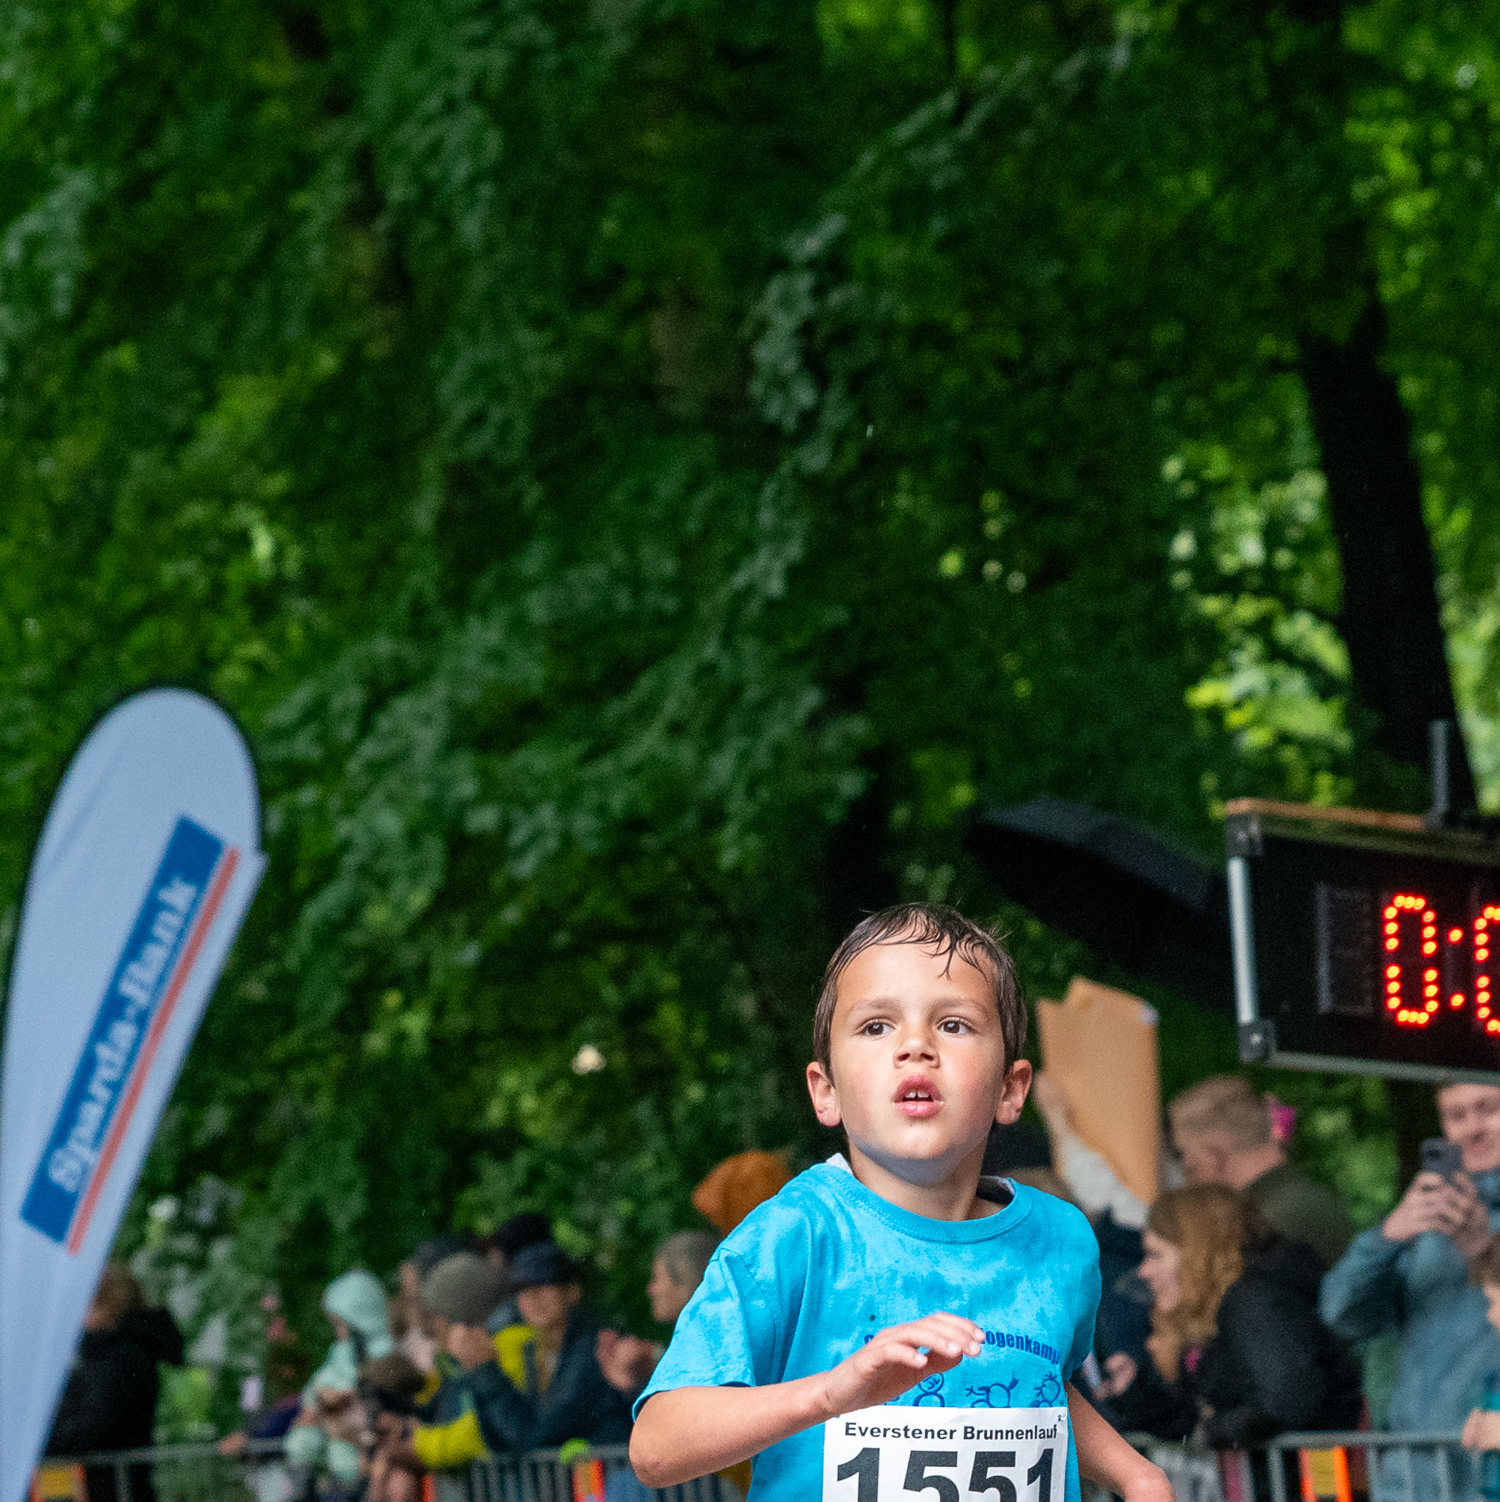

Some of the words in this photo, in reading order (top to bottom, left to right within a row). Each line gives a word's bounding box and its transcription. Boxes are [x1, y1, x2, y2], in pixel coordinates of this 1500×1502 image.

[49, 877, 198, 1193] Sparda-Bank
[981, 1327, 1060, 1365] ogenkamp
[844, 1421, 957, 1440] Everstener
[963, 1423, 1058, 1441] Brunnenlauf
